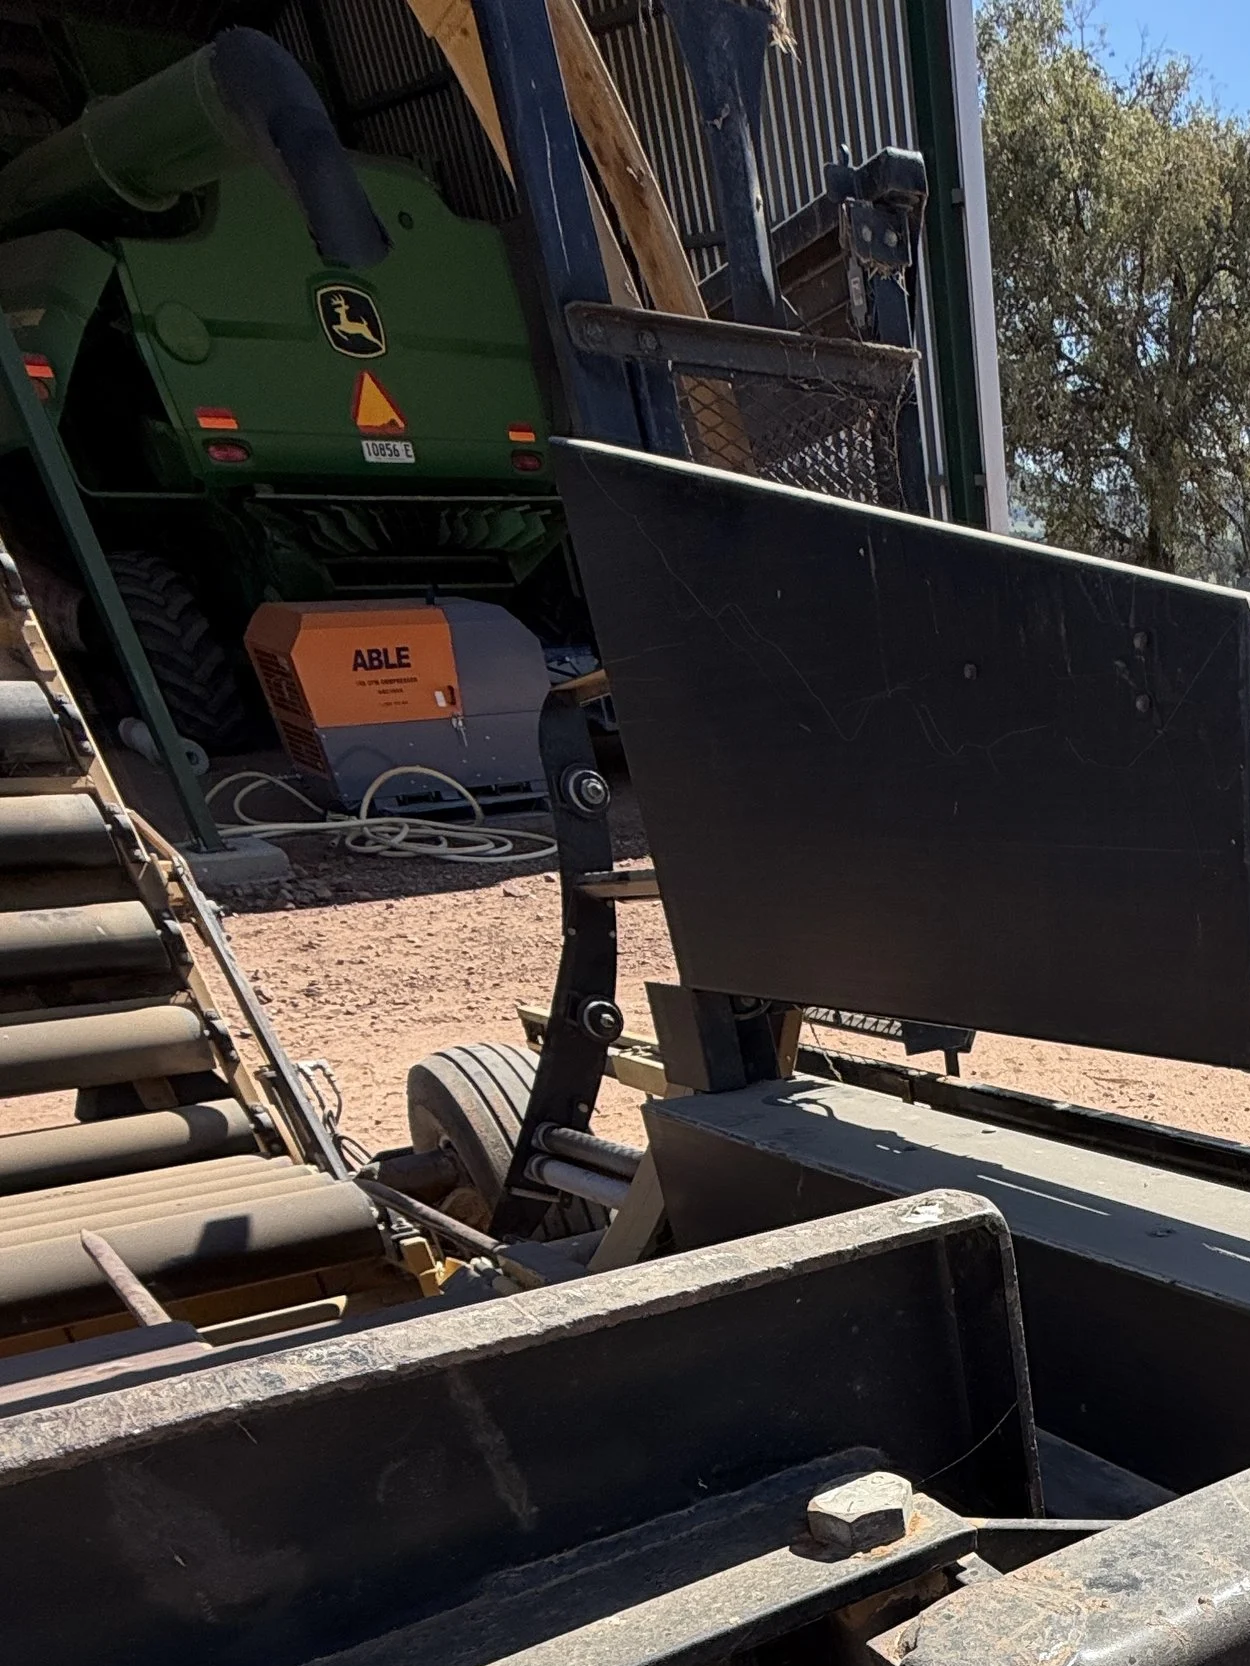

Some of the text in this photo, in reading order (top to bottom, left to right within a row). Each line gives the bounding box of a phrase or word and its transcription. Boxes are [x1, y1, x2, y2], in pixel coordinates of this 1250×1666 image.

[365, 442, 413, 458] 10856 E
[352, 646, 411, 672] ABLE
